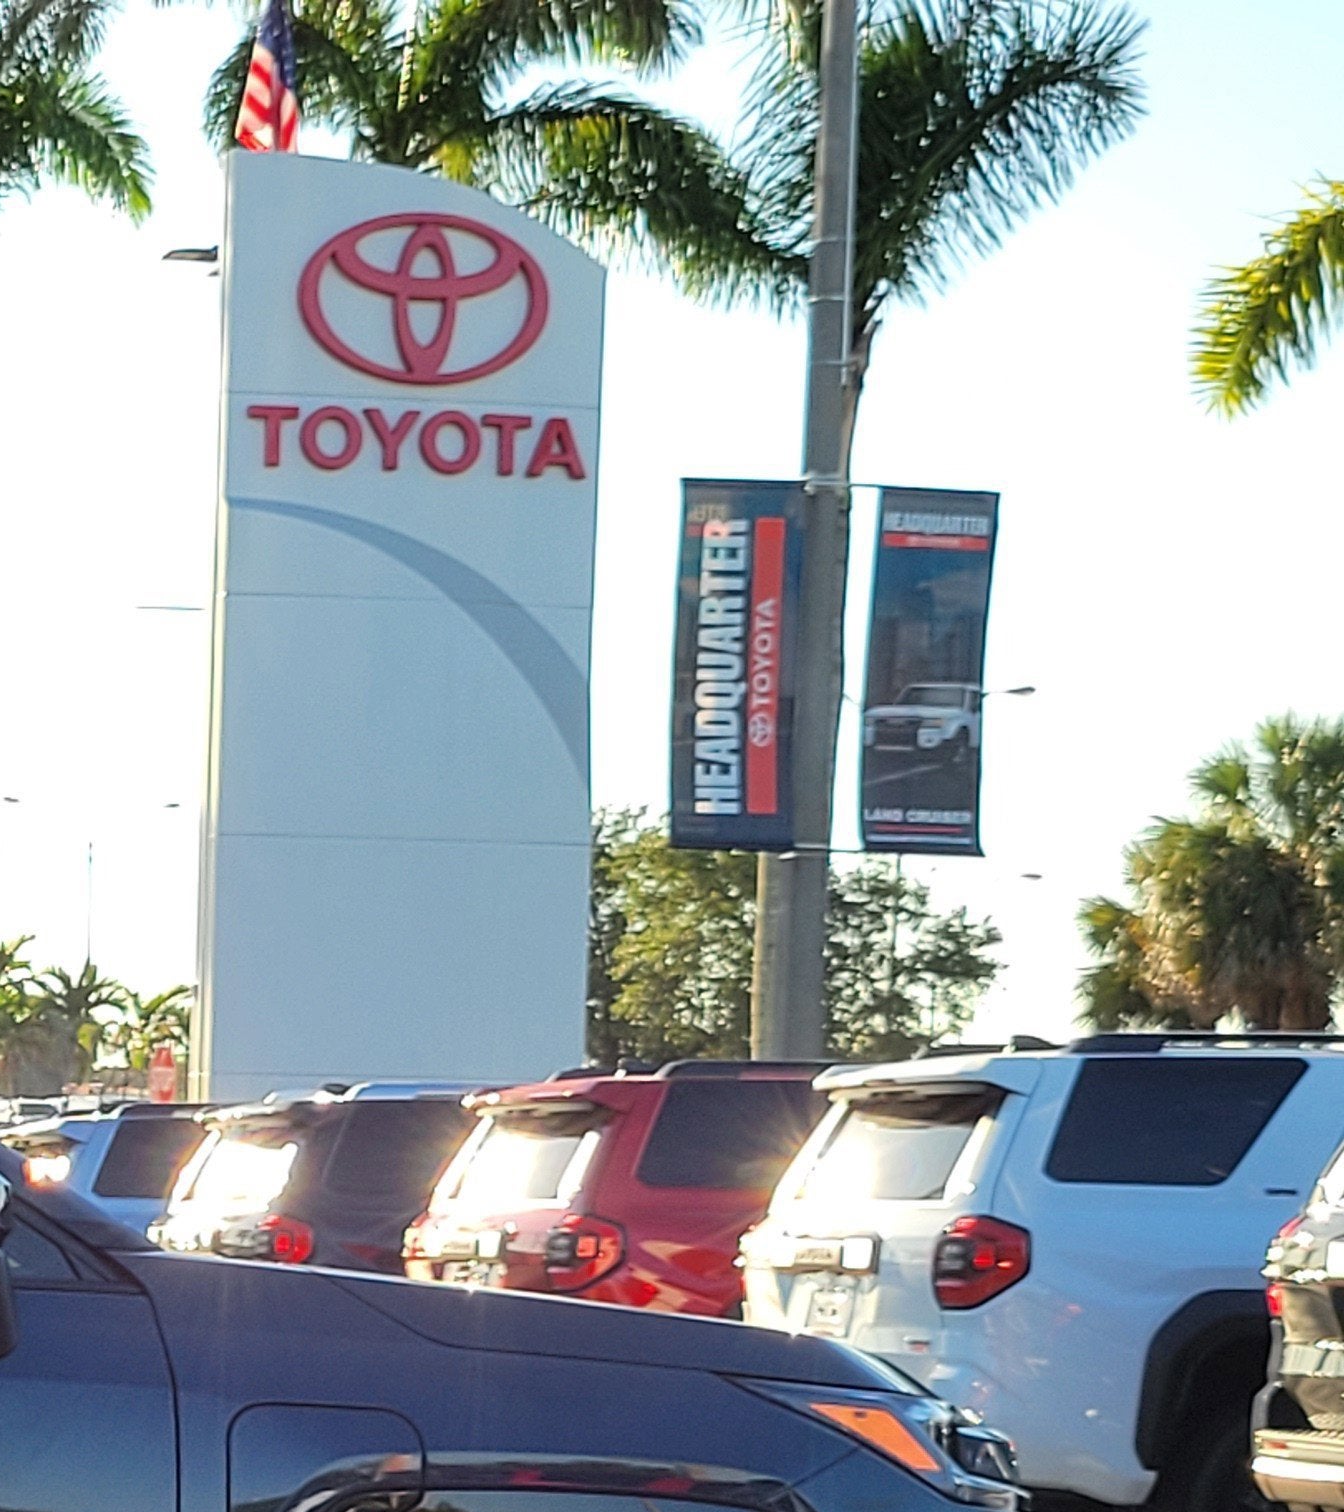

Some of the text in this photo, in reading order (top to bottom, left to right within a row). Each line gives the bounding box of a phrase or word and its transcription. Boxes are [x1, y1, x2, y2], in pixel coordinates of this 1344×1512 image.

[246, 404, 586, 481] TOYOTA
[694, 517, 750, 816] HEADQUARTER
[751, 597, 775, 706] TOYOTA
[864, 806, 904, 822] LAND
